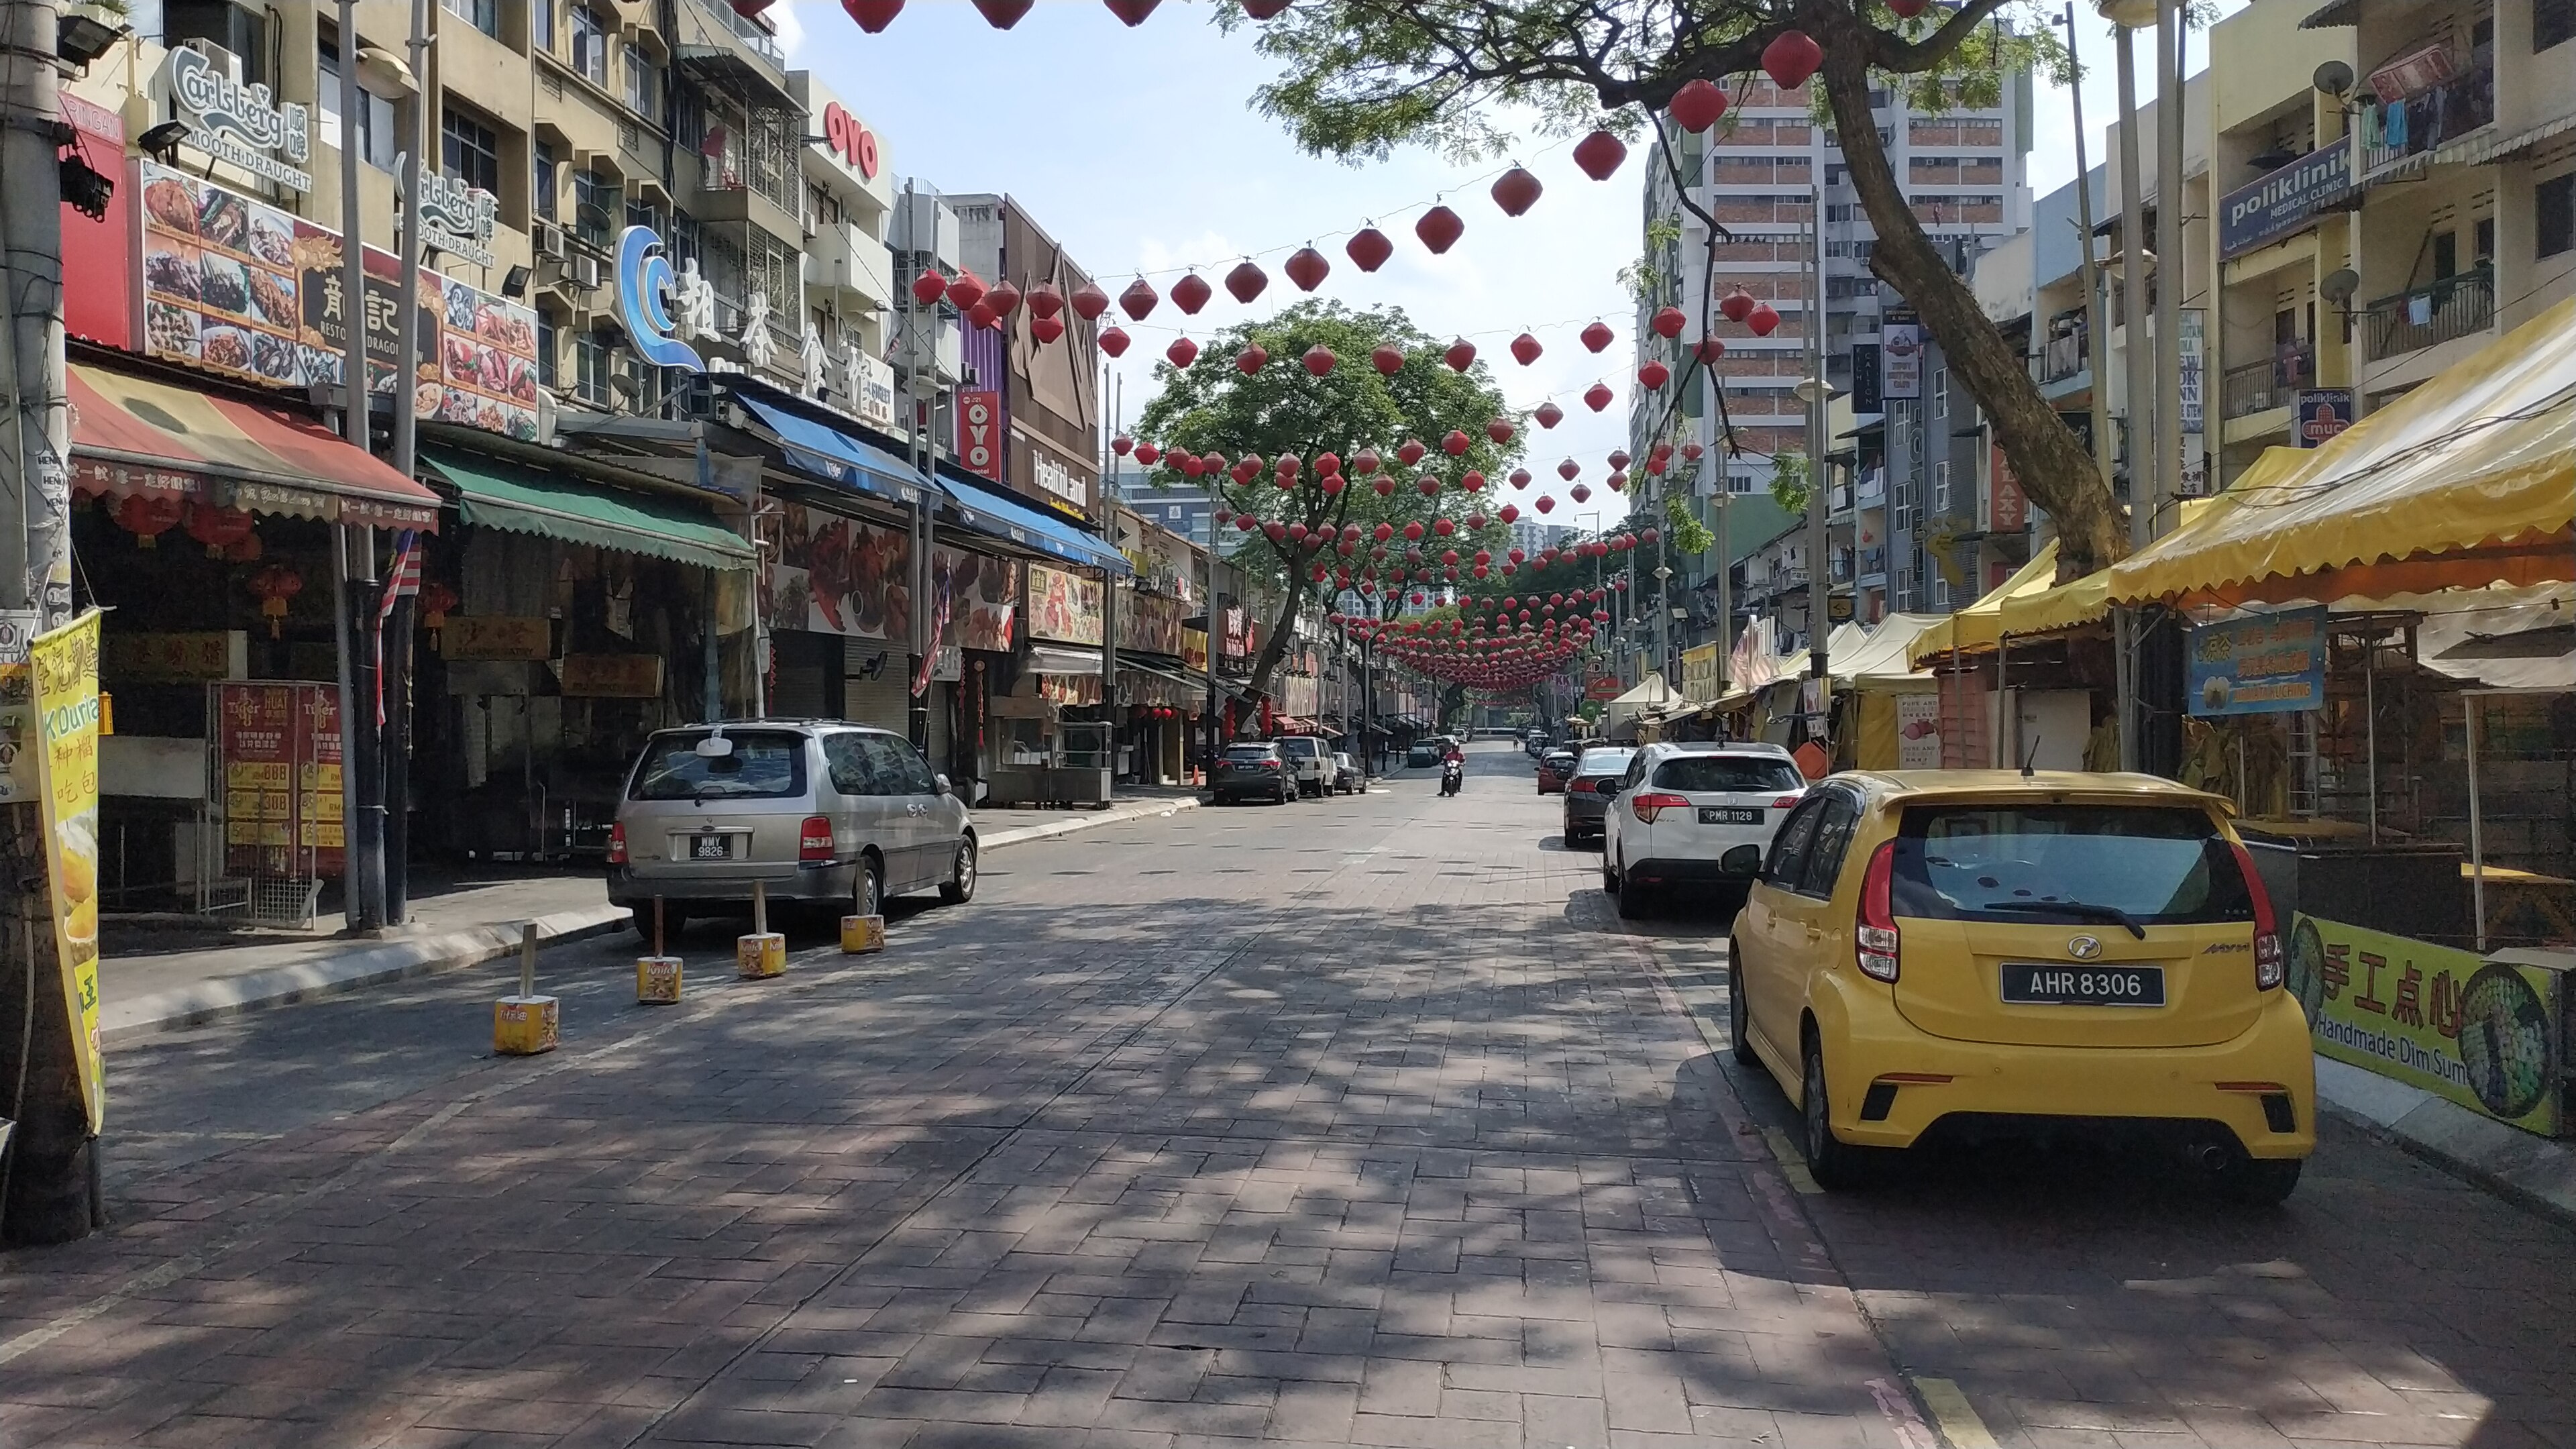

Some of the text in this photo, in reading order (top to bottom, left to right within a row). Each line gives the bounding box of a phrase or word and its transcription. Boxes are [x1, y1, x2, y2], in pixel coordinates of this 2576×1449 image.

[173, 46, 284, 149] Carlsberg
[825, 101, 877, 180] OYO
[2270, 195, 2309, 220] MEDICAL
[2310, 177, 2344, 201] CLINIC
[969, 404, 989, 466] OYO
[1998, 456, 2018, 526] ALAXY
[702, 836, 721, 847] WMY
[1709, 810, 1752, 821] PMR 1128
[698, 846, 724, 857] 9826
[2030, 971, 2143, 997] AHR 8306
[2324, 943, 2461, 1039] 手工点心
[2318, 1010, 2469, 1085] Handmade Dim Sum
